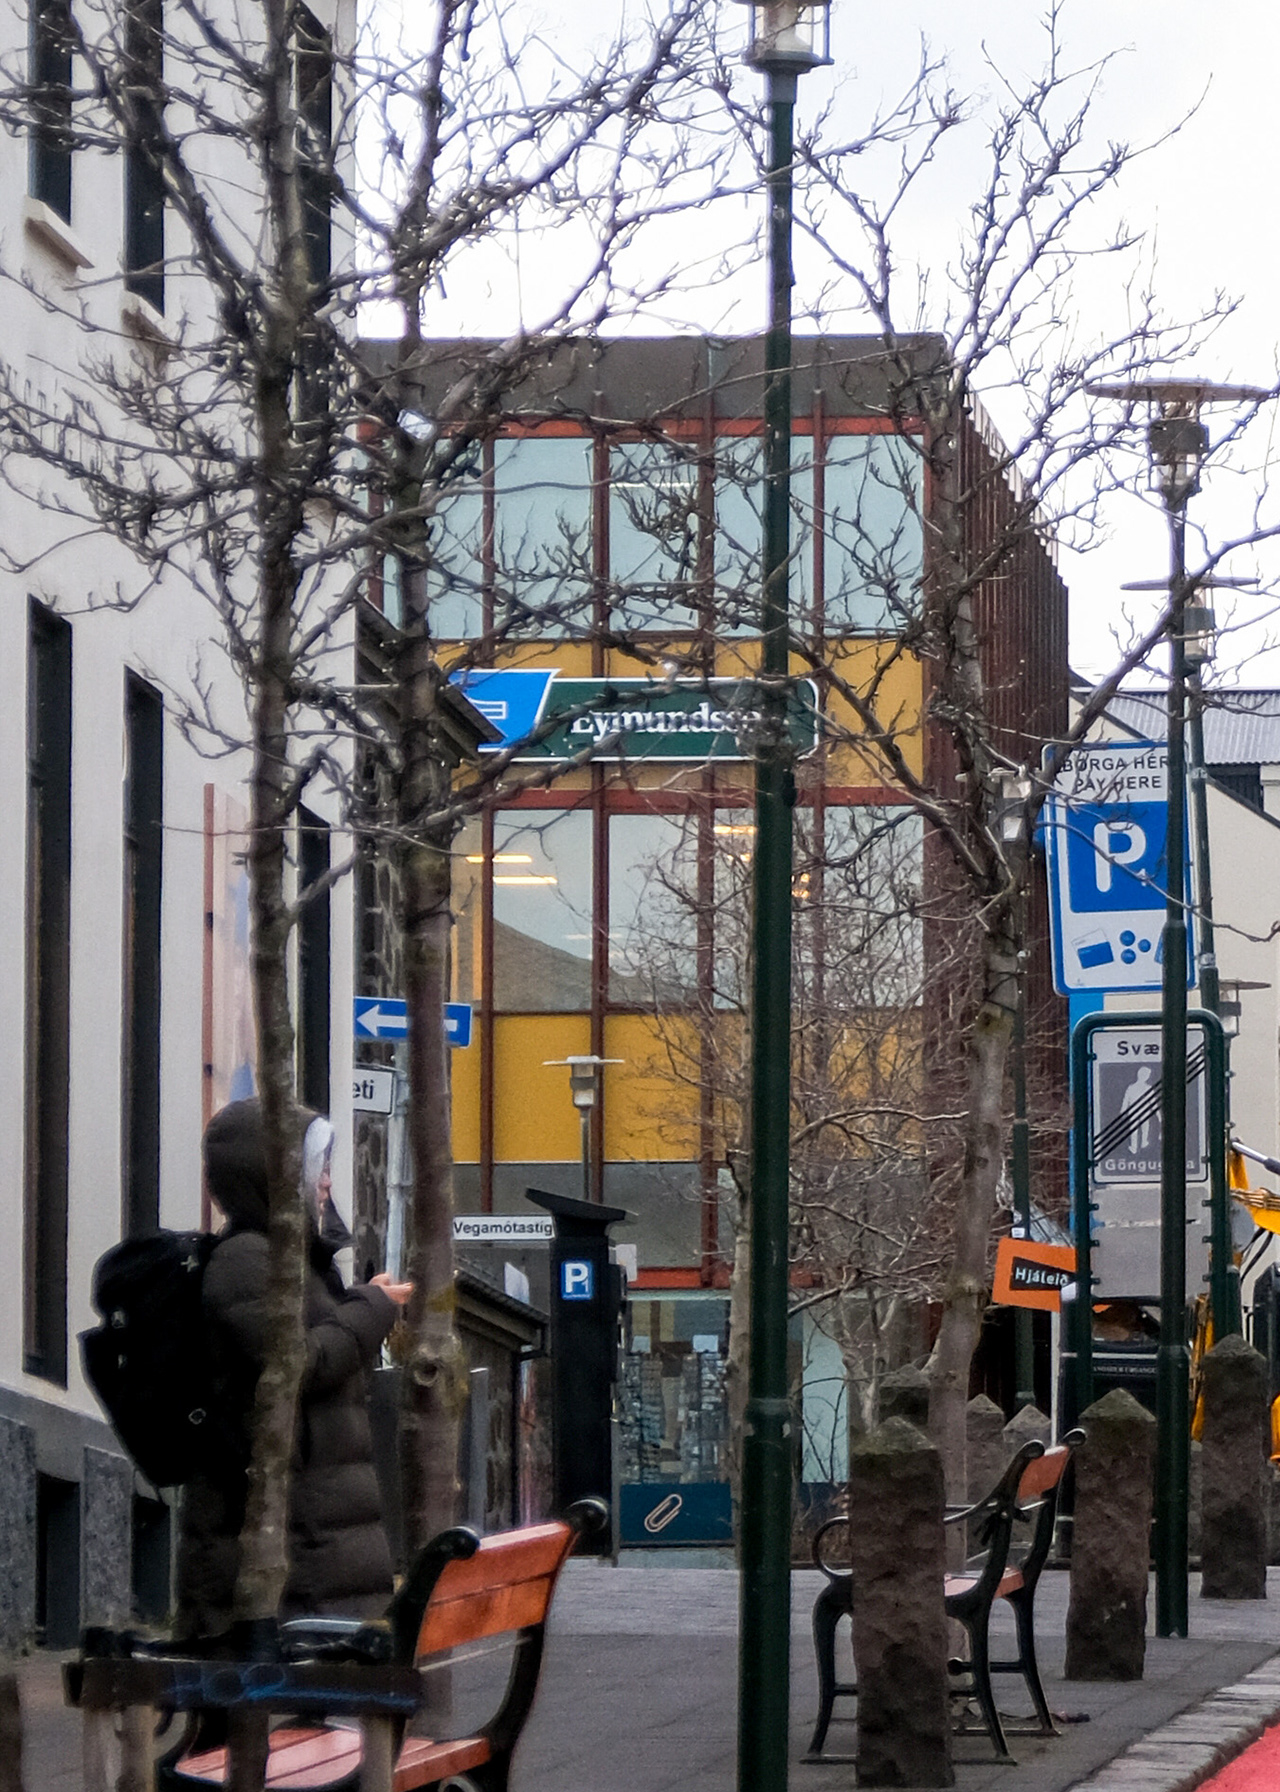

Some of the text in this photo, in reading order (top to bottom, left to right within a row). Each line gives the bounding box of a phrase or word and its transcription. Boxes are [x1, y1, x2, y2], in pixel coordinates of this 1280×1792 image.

[1063, 758, 1127, 773] BORGA
[1076, 775, 1162, 790] PAY HERE
[1117, 1040, 1160, 1056] Svæ
